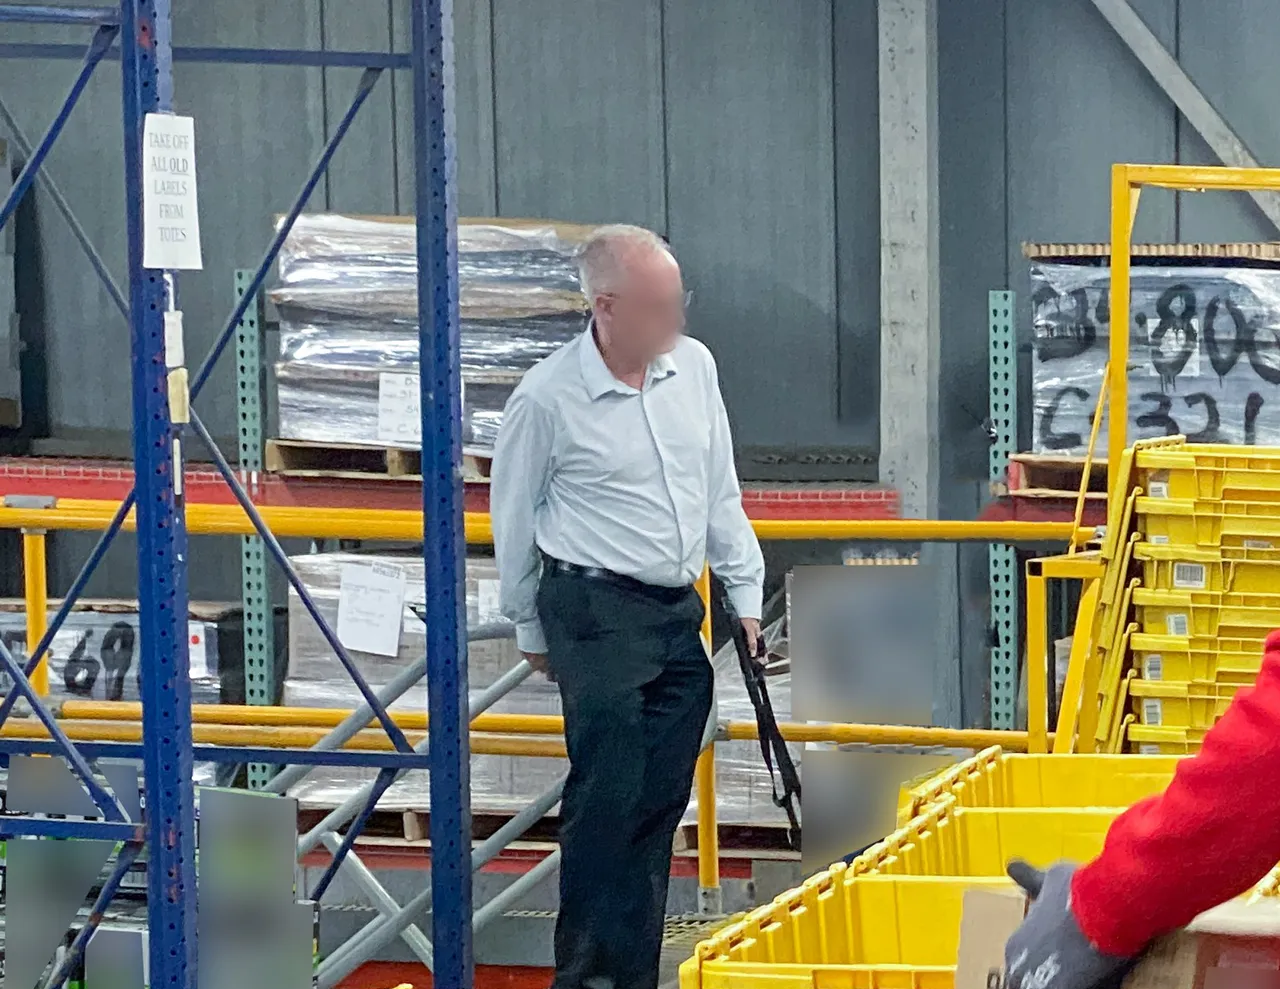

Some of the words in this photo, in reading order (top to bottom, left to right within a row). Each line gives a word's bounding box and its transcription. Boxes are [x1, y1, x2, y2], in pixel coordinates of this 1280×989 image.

[149, 133, 171, 148] TAKE
[173, 134, 189, 150] OFF
[152, 157, 168, 171] ALL
[170, 157, 188, 173] OLD
[154, 180, 187, 196] LABELS
[159, 203, 184, 219] FROM
[158, 227, 187, 242] TOTES
